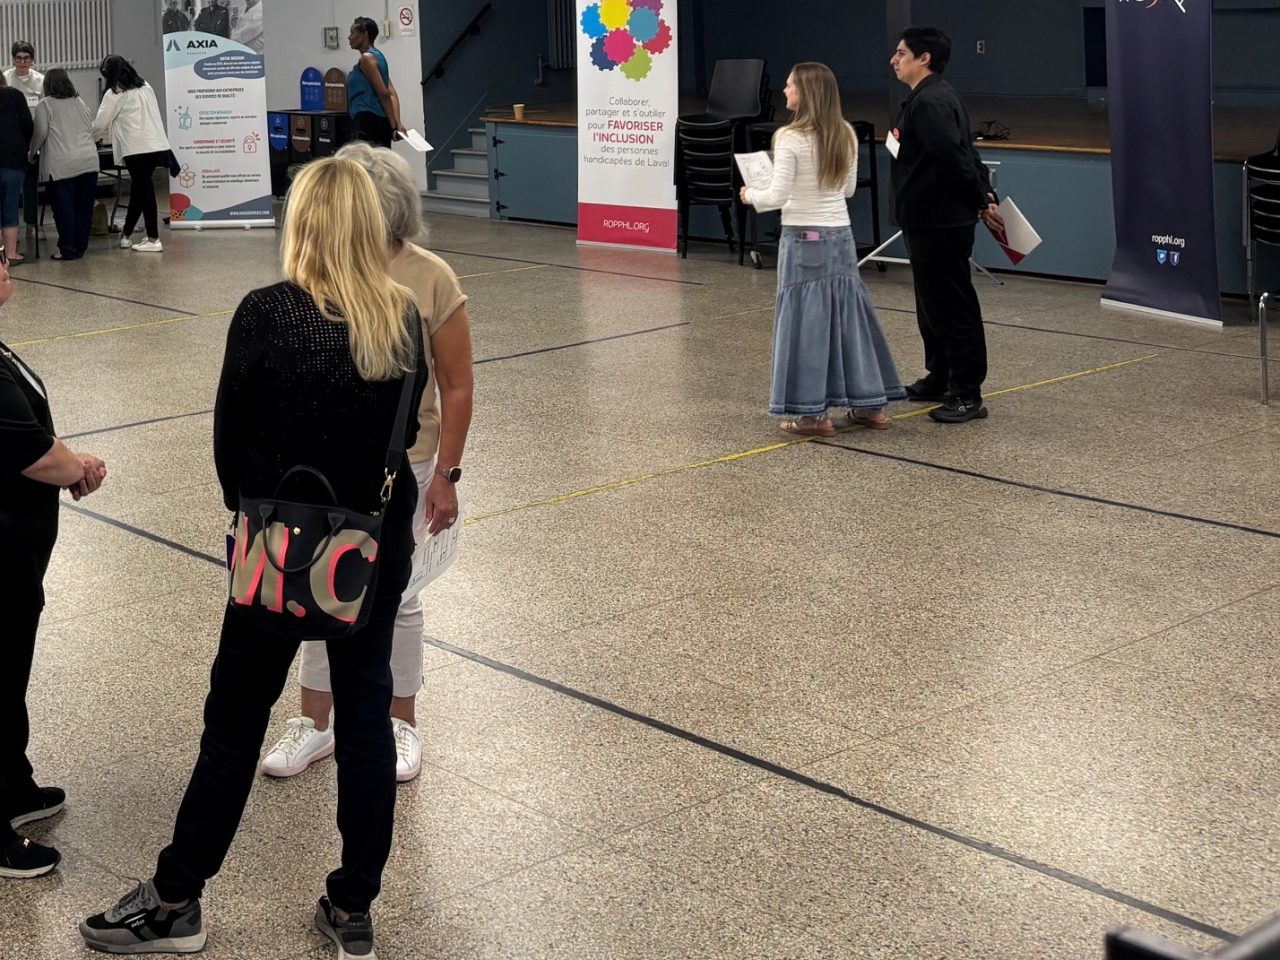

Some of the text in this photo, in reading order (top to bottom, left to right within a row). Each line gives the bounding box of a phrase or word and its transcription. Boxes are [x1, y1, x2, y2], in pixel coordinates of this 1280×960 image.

[186, 39, 218, 49] AXIA
[608, 96, 651, 107] Collaborer,
[585, 108, 666, 118] partager et s'outiller
[587, 120, 664, 131] pour FAVORISER
[600, 145, 659, 156] des personnes
[583, 155, 670, 168] handicapées de Laval
[1152, 234, 1185, 248] ropphl.org
